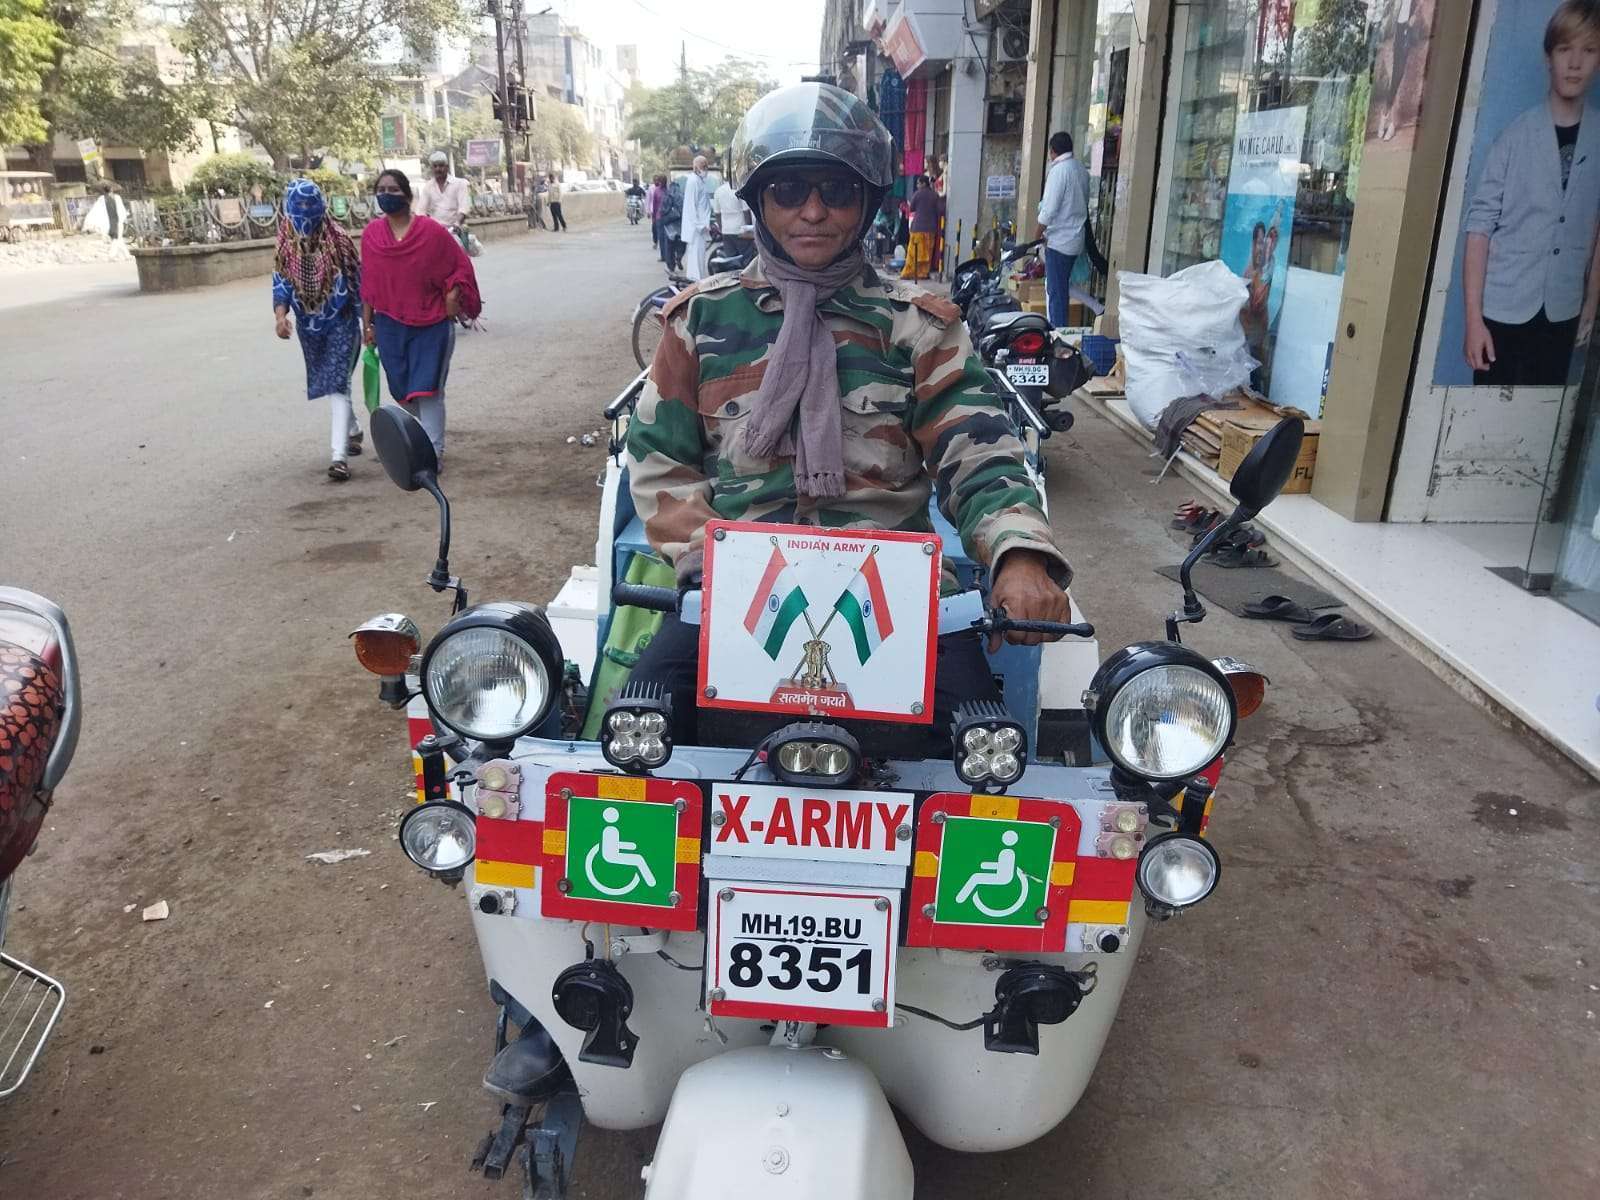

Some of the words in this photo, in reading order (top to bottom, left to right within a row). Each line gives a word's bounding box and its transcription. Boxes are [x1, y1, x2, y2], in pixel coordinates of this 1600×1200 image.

[1262, 135, 1284, 154] CARLO
[1009, 374, 1047, 384] 6342
[787, 540, 830, 551] INDIAN
[833, 542, 866, 553] ARMY
[778, 691, 818, 706] सत्यमेव
[820, 693, 846, 708] जयते
[715, 794, 910, 851] X-ARMY
[741, 913, 862, 939] MH.19.BU
[728, 942, 872, 994] 8351
